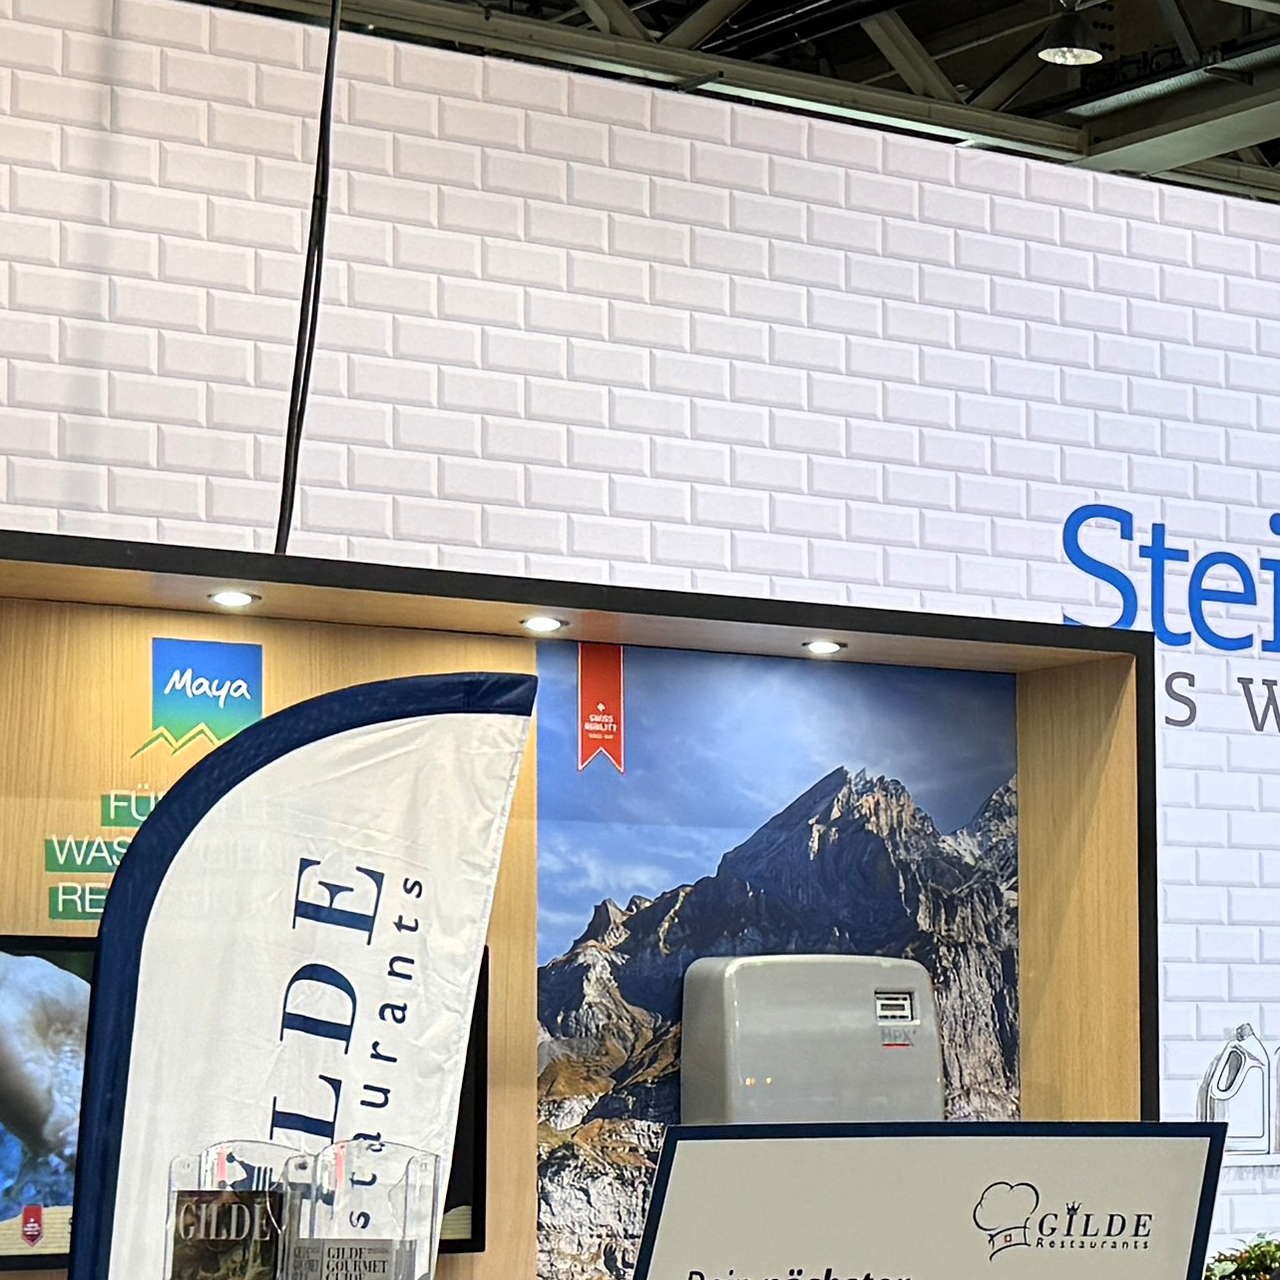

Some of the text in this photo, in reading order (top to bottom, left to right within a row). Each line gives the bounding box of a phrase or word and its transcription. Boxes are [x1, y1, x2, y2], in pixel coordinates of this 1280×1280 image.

[163, 667, 251, 709] Maya
[109, 783, 167, 822] FÜ
[179, 1203, 271, 1241] GILDE
[1038, 1211, 1153, 1238] GILDE
[1036, 1237, 1149, 1249] Restaurants
